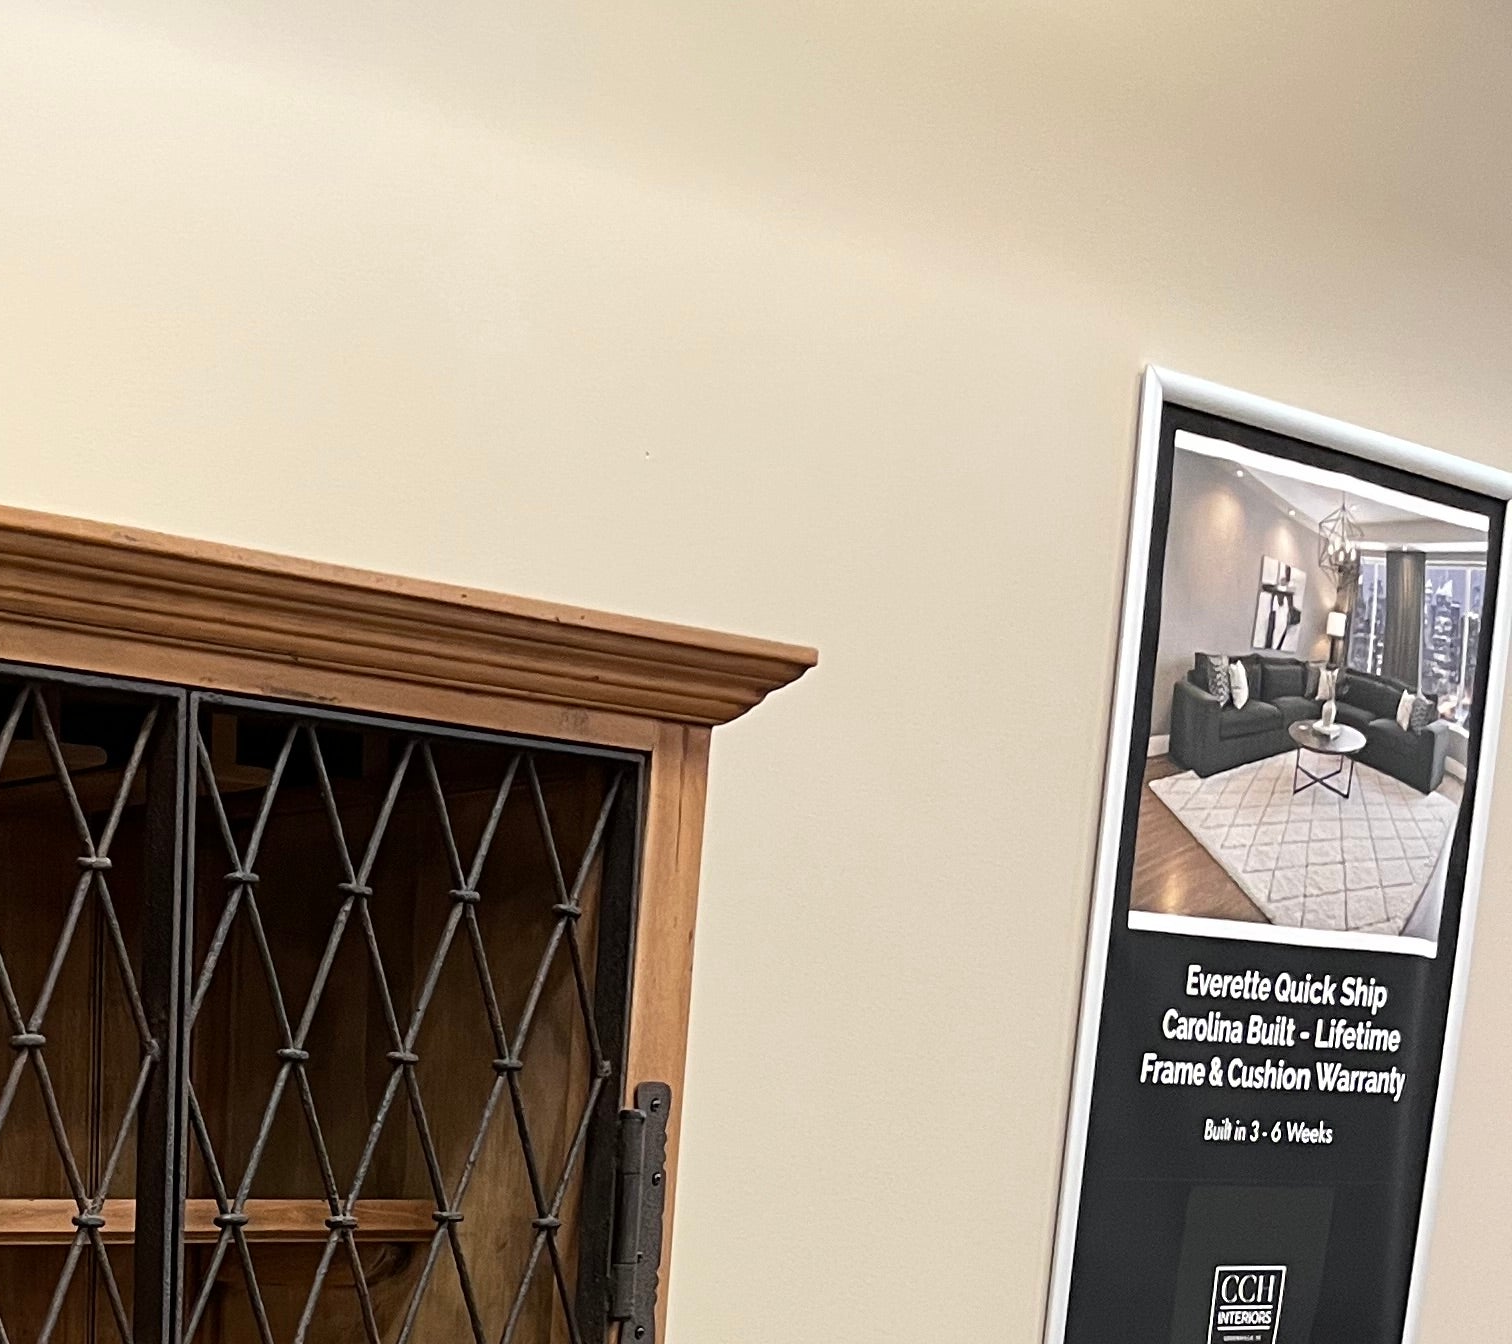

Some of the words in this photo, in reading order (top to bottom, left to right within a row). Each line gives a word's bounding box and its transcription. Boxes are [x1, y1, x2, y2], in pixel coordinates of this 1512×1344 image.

[1186, 964, 1271, 1001] Everette
[1275, 972, 1337, 1006] Quick
[1339, 976, 1387, 1015] Ship
[1162, 1008, 1242, 1043] Carolina
[1246, 1014, 1296, 1047] Built
[1299, 1031, 1310, 1040] -
[1314, 1019, 1401, 1052] Lifetime
[1140, 1052, 1205, 1086] Frame
[1208, 1056, 1223, 1087] &
[1227, 1057, 1311, 1091] Cushion
[1315, 1061, 1406, 1102] Warranty
[1203, 1117, 1233, 1142] Built
[1234, 1119, 1246, 1142] in
[1249, 1120, 1260, 1142] 3
[1270, 1121, 1282, 1143] 6
[1286, 1121, 1333, 1144] Weeks
[1221, 1274, 1275, 1303] CCH
[1217, 1310, 1272, 1325] INTERIORS
